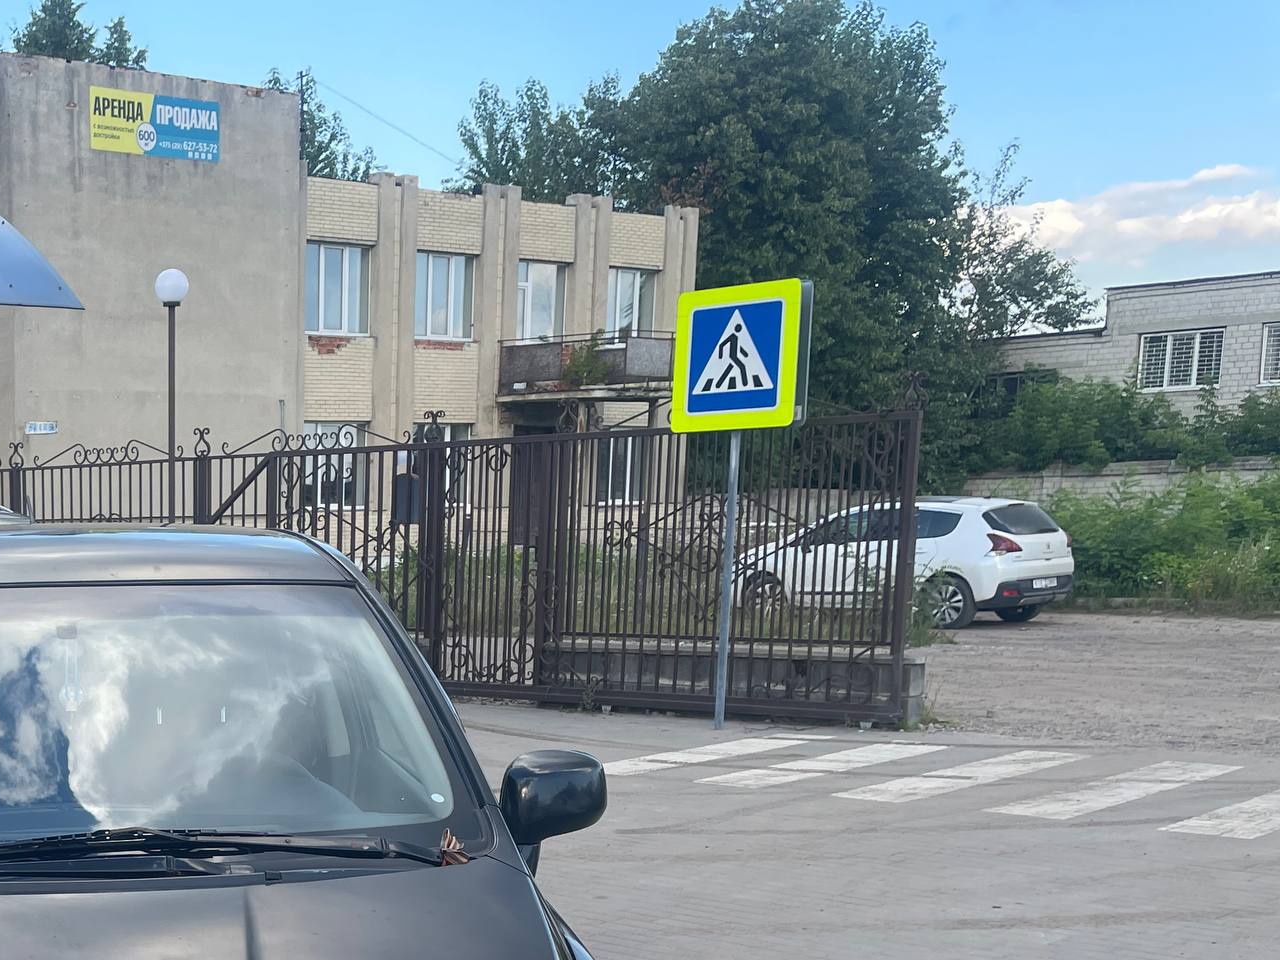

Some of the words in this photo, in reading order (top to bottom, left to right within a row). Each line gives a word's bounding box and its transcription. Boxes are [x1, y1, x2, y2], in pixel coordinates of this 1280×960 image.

[93, 96, 144, 123] АРЕНДА
[156, 104, 218, 131] ПРОДАЖА
[138, 130, 155, 142] 600
[183, 141, 218, 153] 627-53-72
